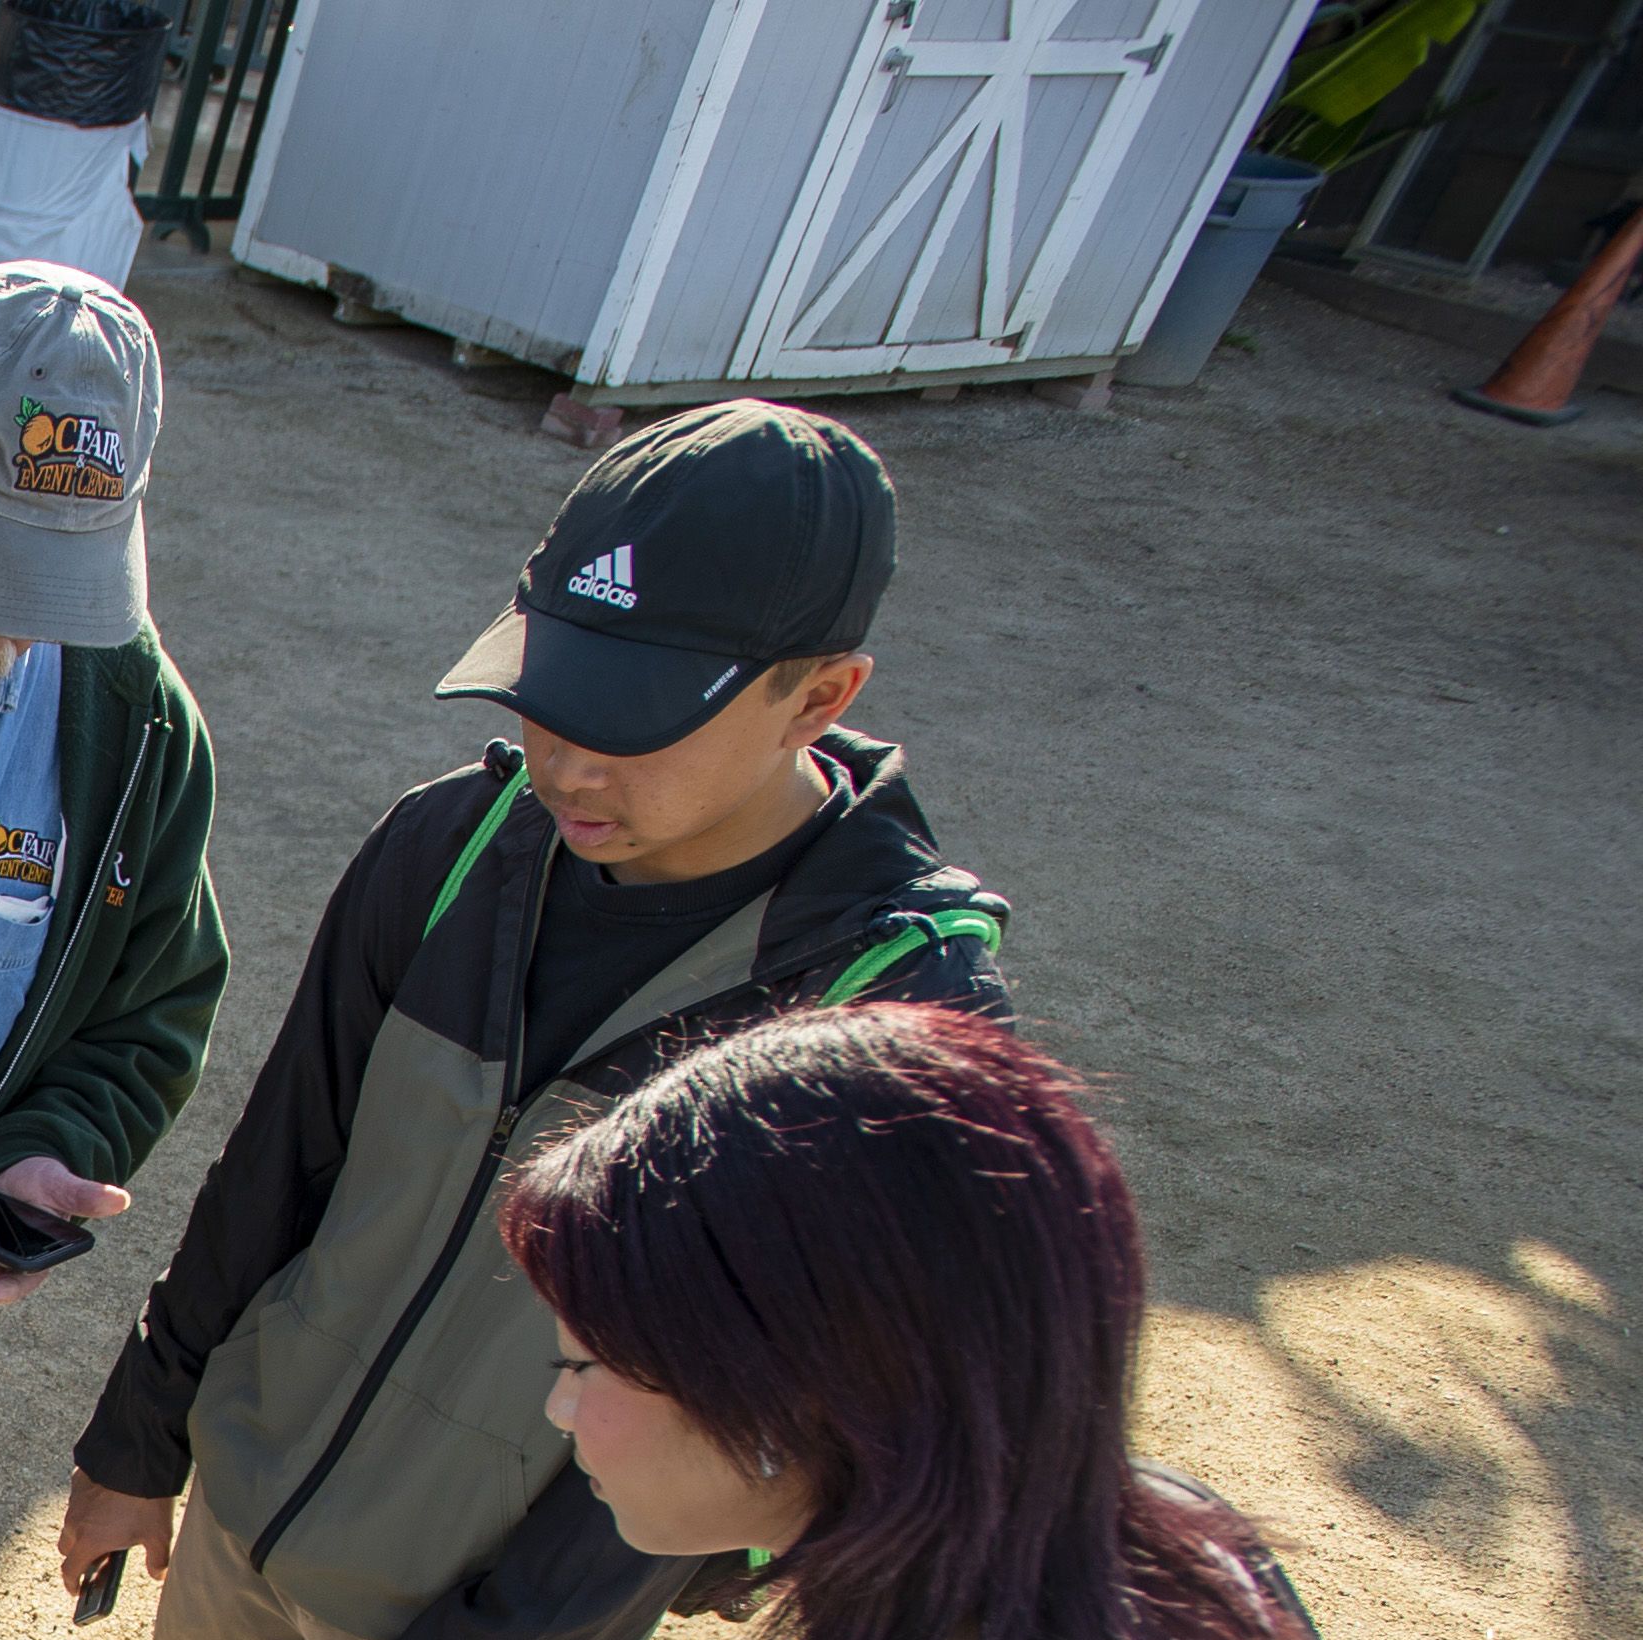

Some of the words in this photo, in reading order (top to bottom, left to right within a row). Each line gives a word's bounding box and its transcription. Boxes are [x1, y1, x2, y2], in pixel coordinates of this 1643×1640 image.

[16, 455, 77, 493] EVENT
[77, 466, 124, 498] CENTER
[76, 454, 86, 469] &
[567, 575, 638, 610] adidas
